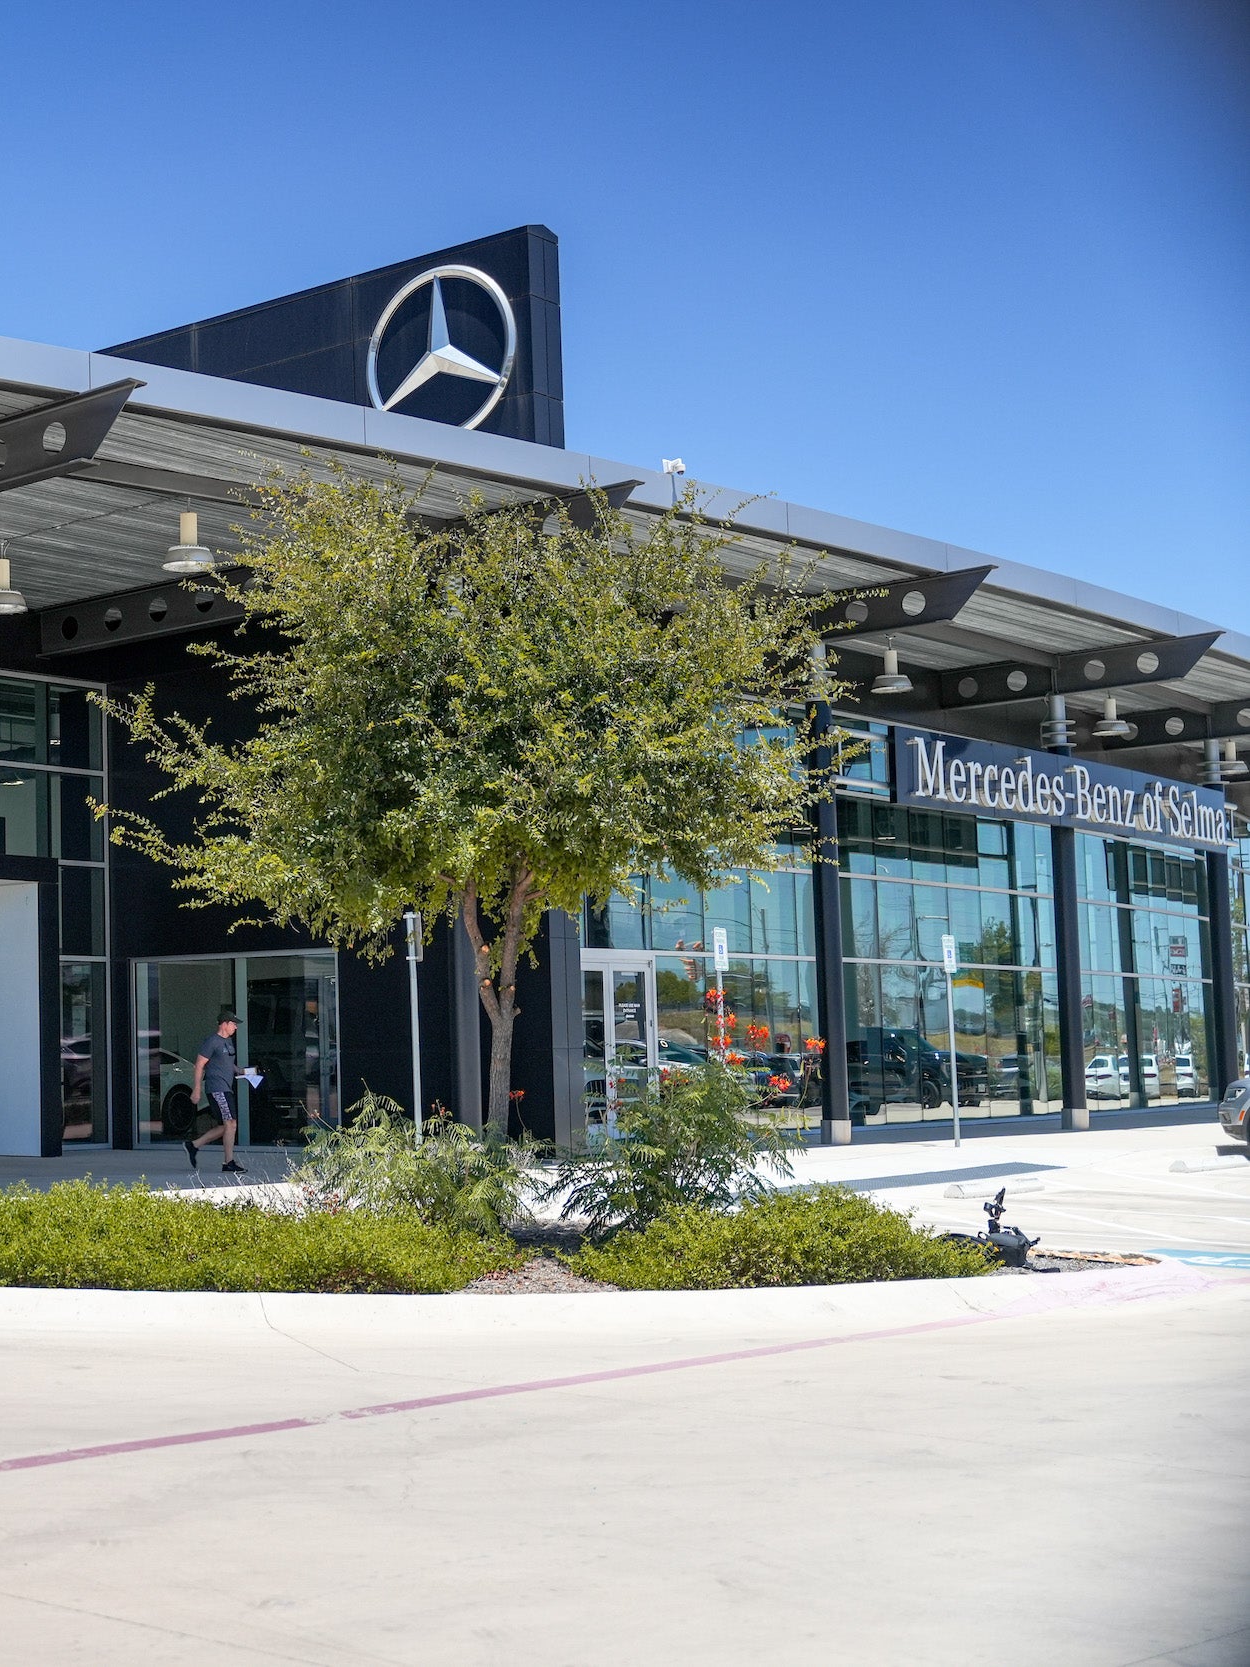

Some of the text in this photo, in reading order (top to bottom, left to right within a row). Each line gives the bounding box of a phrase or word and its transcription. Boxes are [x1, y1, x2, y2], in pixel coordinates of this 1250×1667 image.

[913, 737, 1228, 846] Mercedes-Benz of Selma
